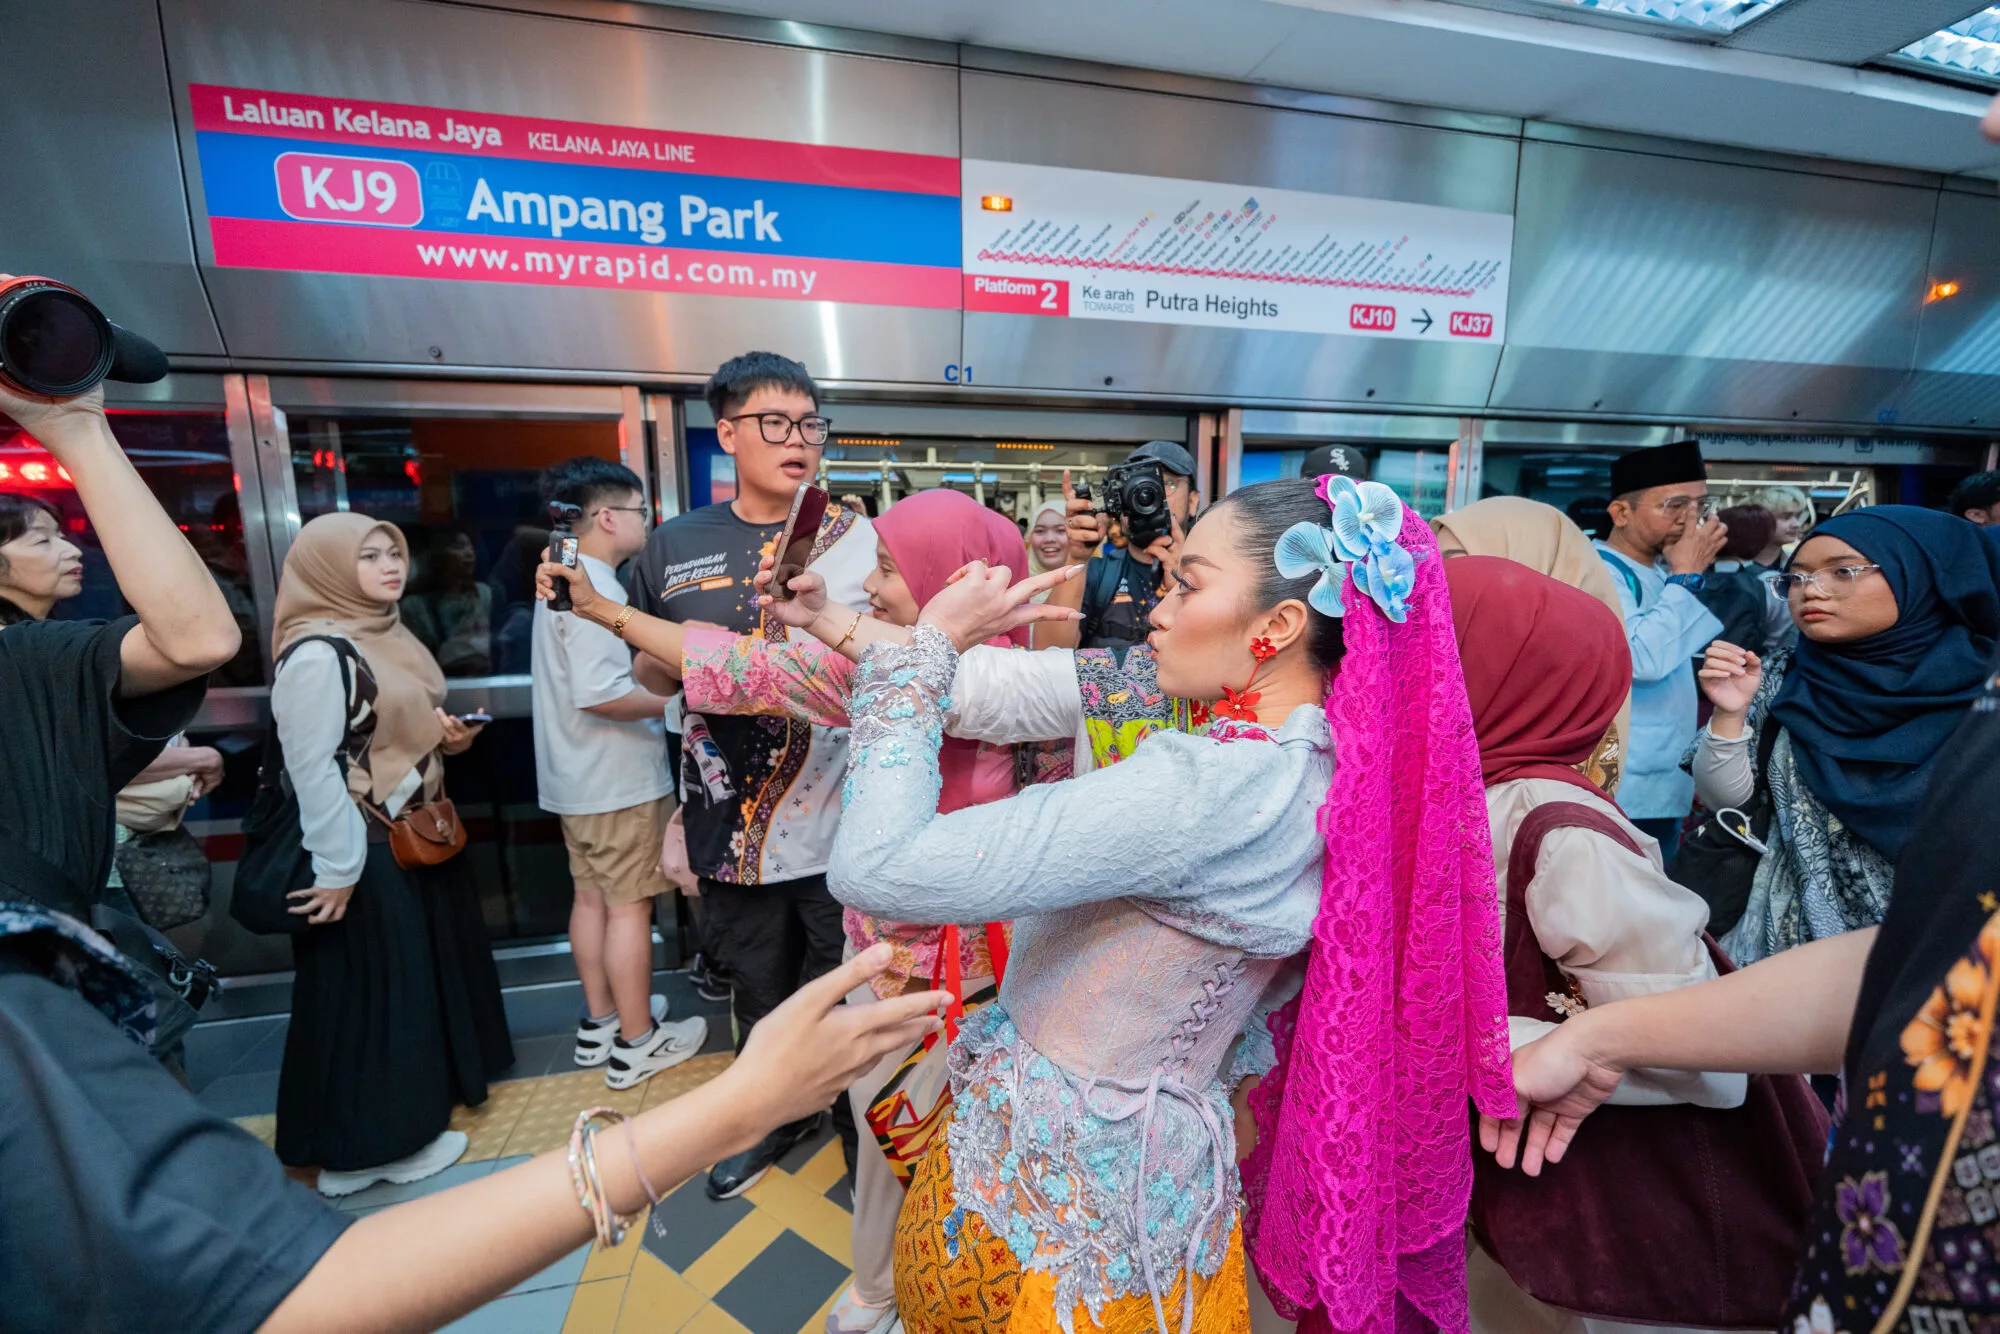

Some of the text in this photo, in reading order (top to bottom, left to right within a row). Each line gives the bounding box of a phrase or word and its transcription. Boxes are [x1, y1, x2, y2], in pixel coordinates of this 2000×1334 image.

[223, 95, 503, 149] Laluan Kelana Jaya
[527, 131, 696, 164] KELANA JAYA LINE
[300, 165, 398, 215] KJ9
[466, 177, 783, 244] Ampang Park
[416, 243, 818, 295] www.myrapid.com.my
[974, 276, 1058, 310] Platform 2
[1082, 285, 1135, 301] Ke arah
[1082, 300, 1135, 314] TOWARDS
[1146, 289, 1279, 320] Putra Heights
[1353, 307, 1393, 327] KJ10
[1452, 314, 1492, 334] KJ37
